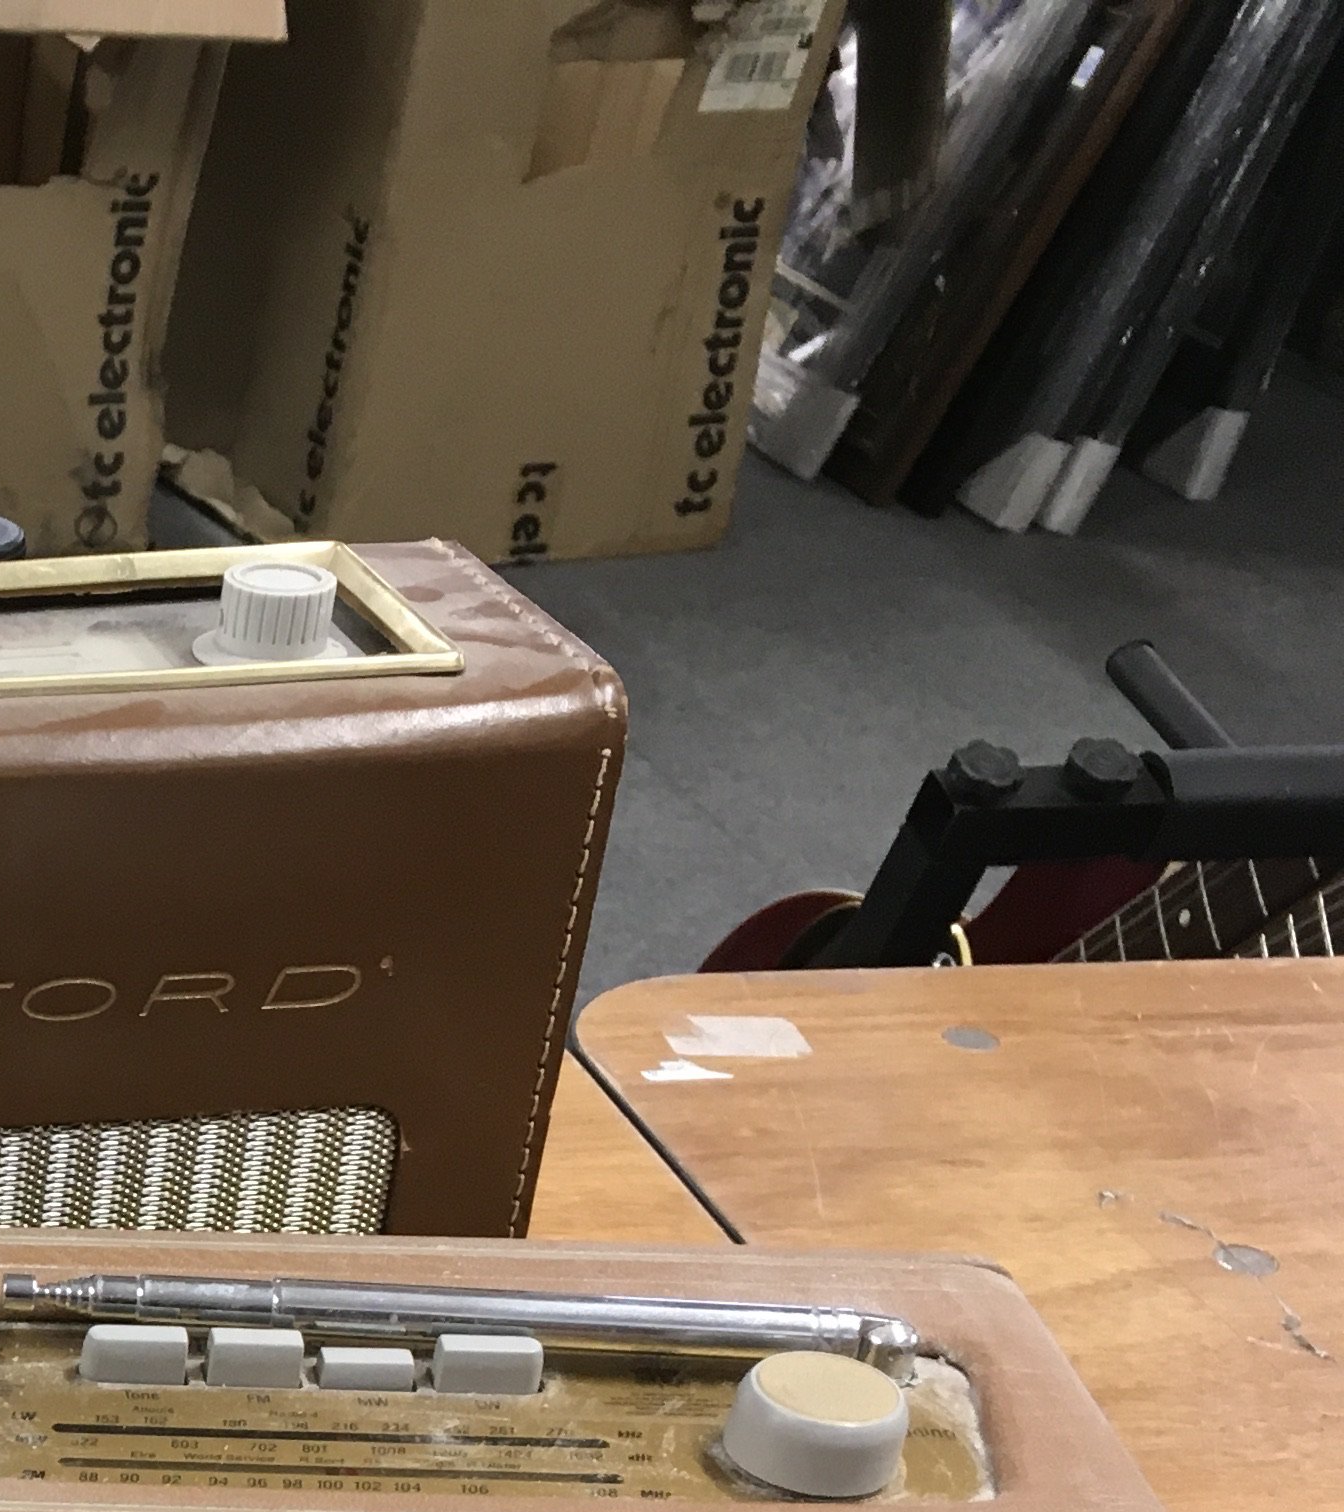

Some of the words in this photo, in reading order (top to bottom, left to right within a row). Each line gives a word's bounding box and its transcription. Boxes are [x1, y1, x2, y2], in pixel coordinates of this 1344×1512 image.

[88, 171, 160, 440] electronic
[688, 197, 765, 458] electronic
[83, 451, 124, 499] tc
[517, 462, 556, 504] tc
[674, 468, 718, 517] tc
[78, 1472, 99, 1482] 88
[120, 1473, 140, 1483] 90
[161, 1475, 182, 1485] 92
[208, 1476, 229, 1486] 94
[247, 1478, 268, 1488] 96
[282, 1479, 303, 1489] 98
[317, 1480, 344, 1490] 100
[354, 1481, 382, 1492] 102
[394, 1482, 422, 1493] 104
[460, 1484, 489, 1495] 106
